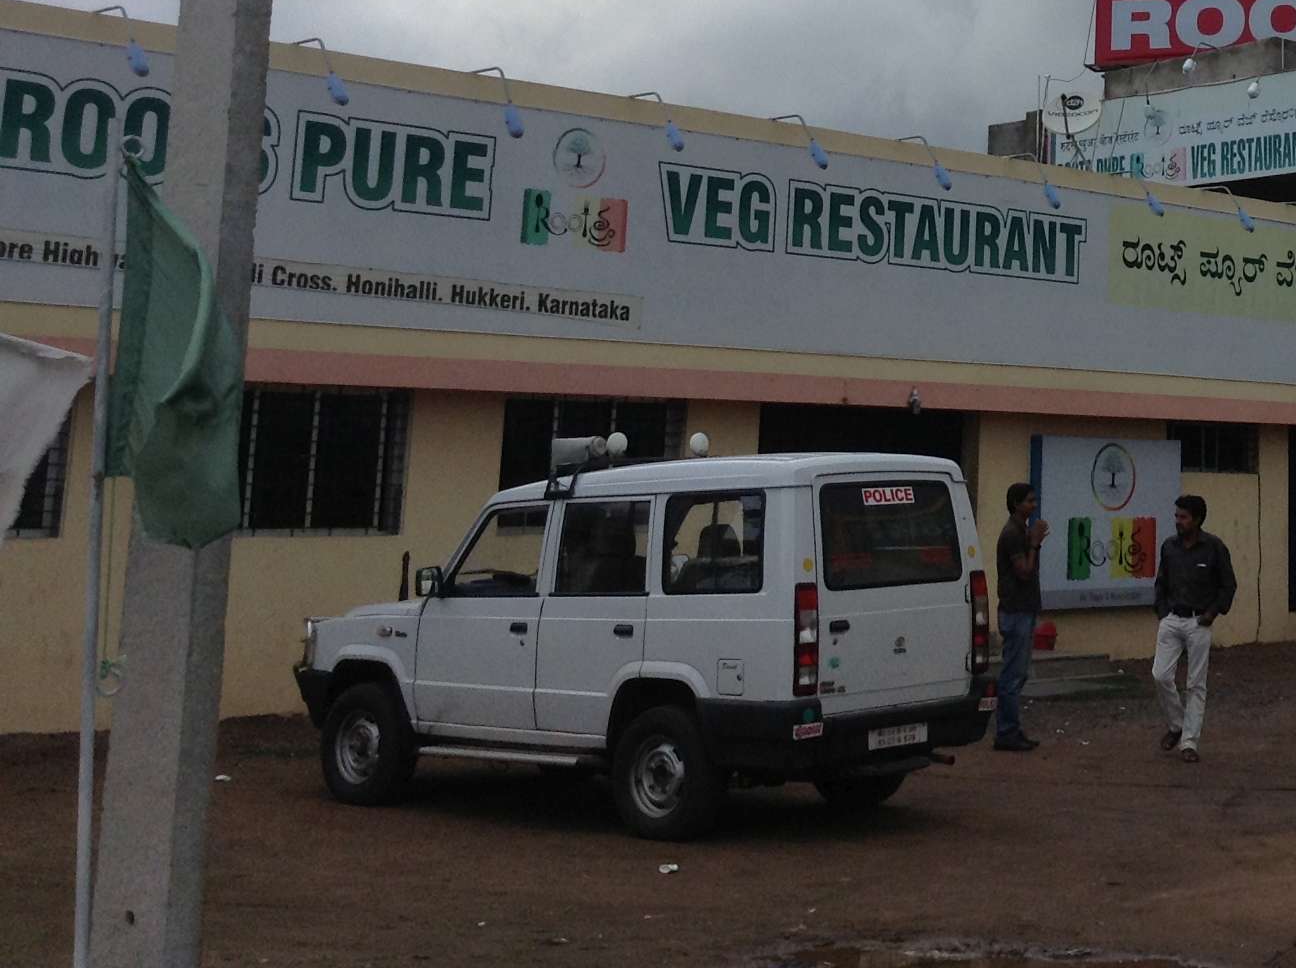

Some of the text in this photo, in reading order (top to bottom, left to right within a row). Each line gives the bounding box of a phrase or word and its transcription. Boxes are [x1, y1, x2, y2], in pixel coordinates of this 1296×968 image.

[299, 119, 489, 212] PURE
[1191, 142, 1217, 180] VEG
[666, 169, 1083, 278] VEG RESTAURANT
[537, 292, 631, 322] Karnataka
[864, 488, 913, 503] POLICE
